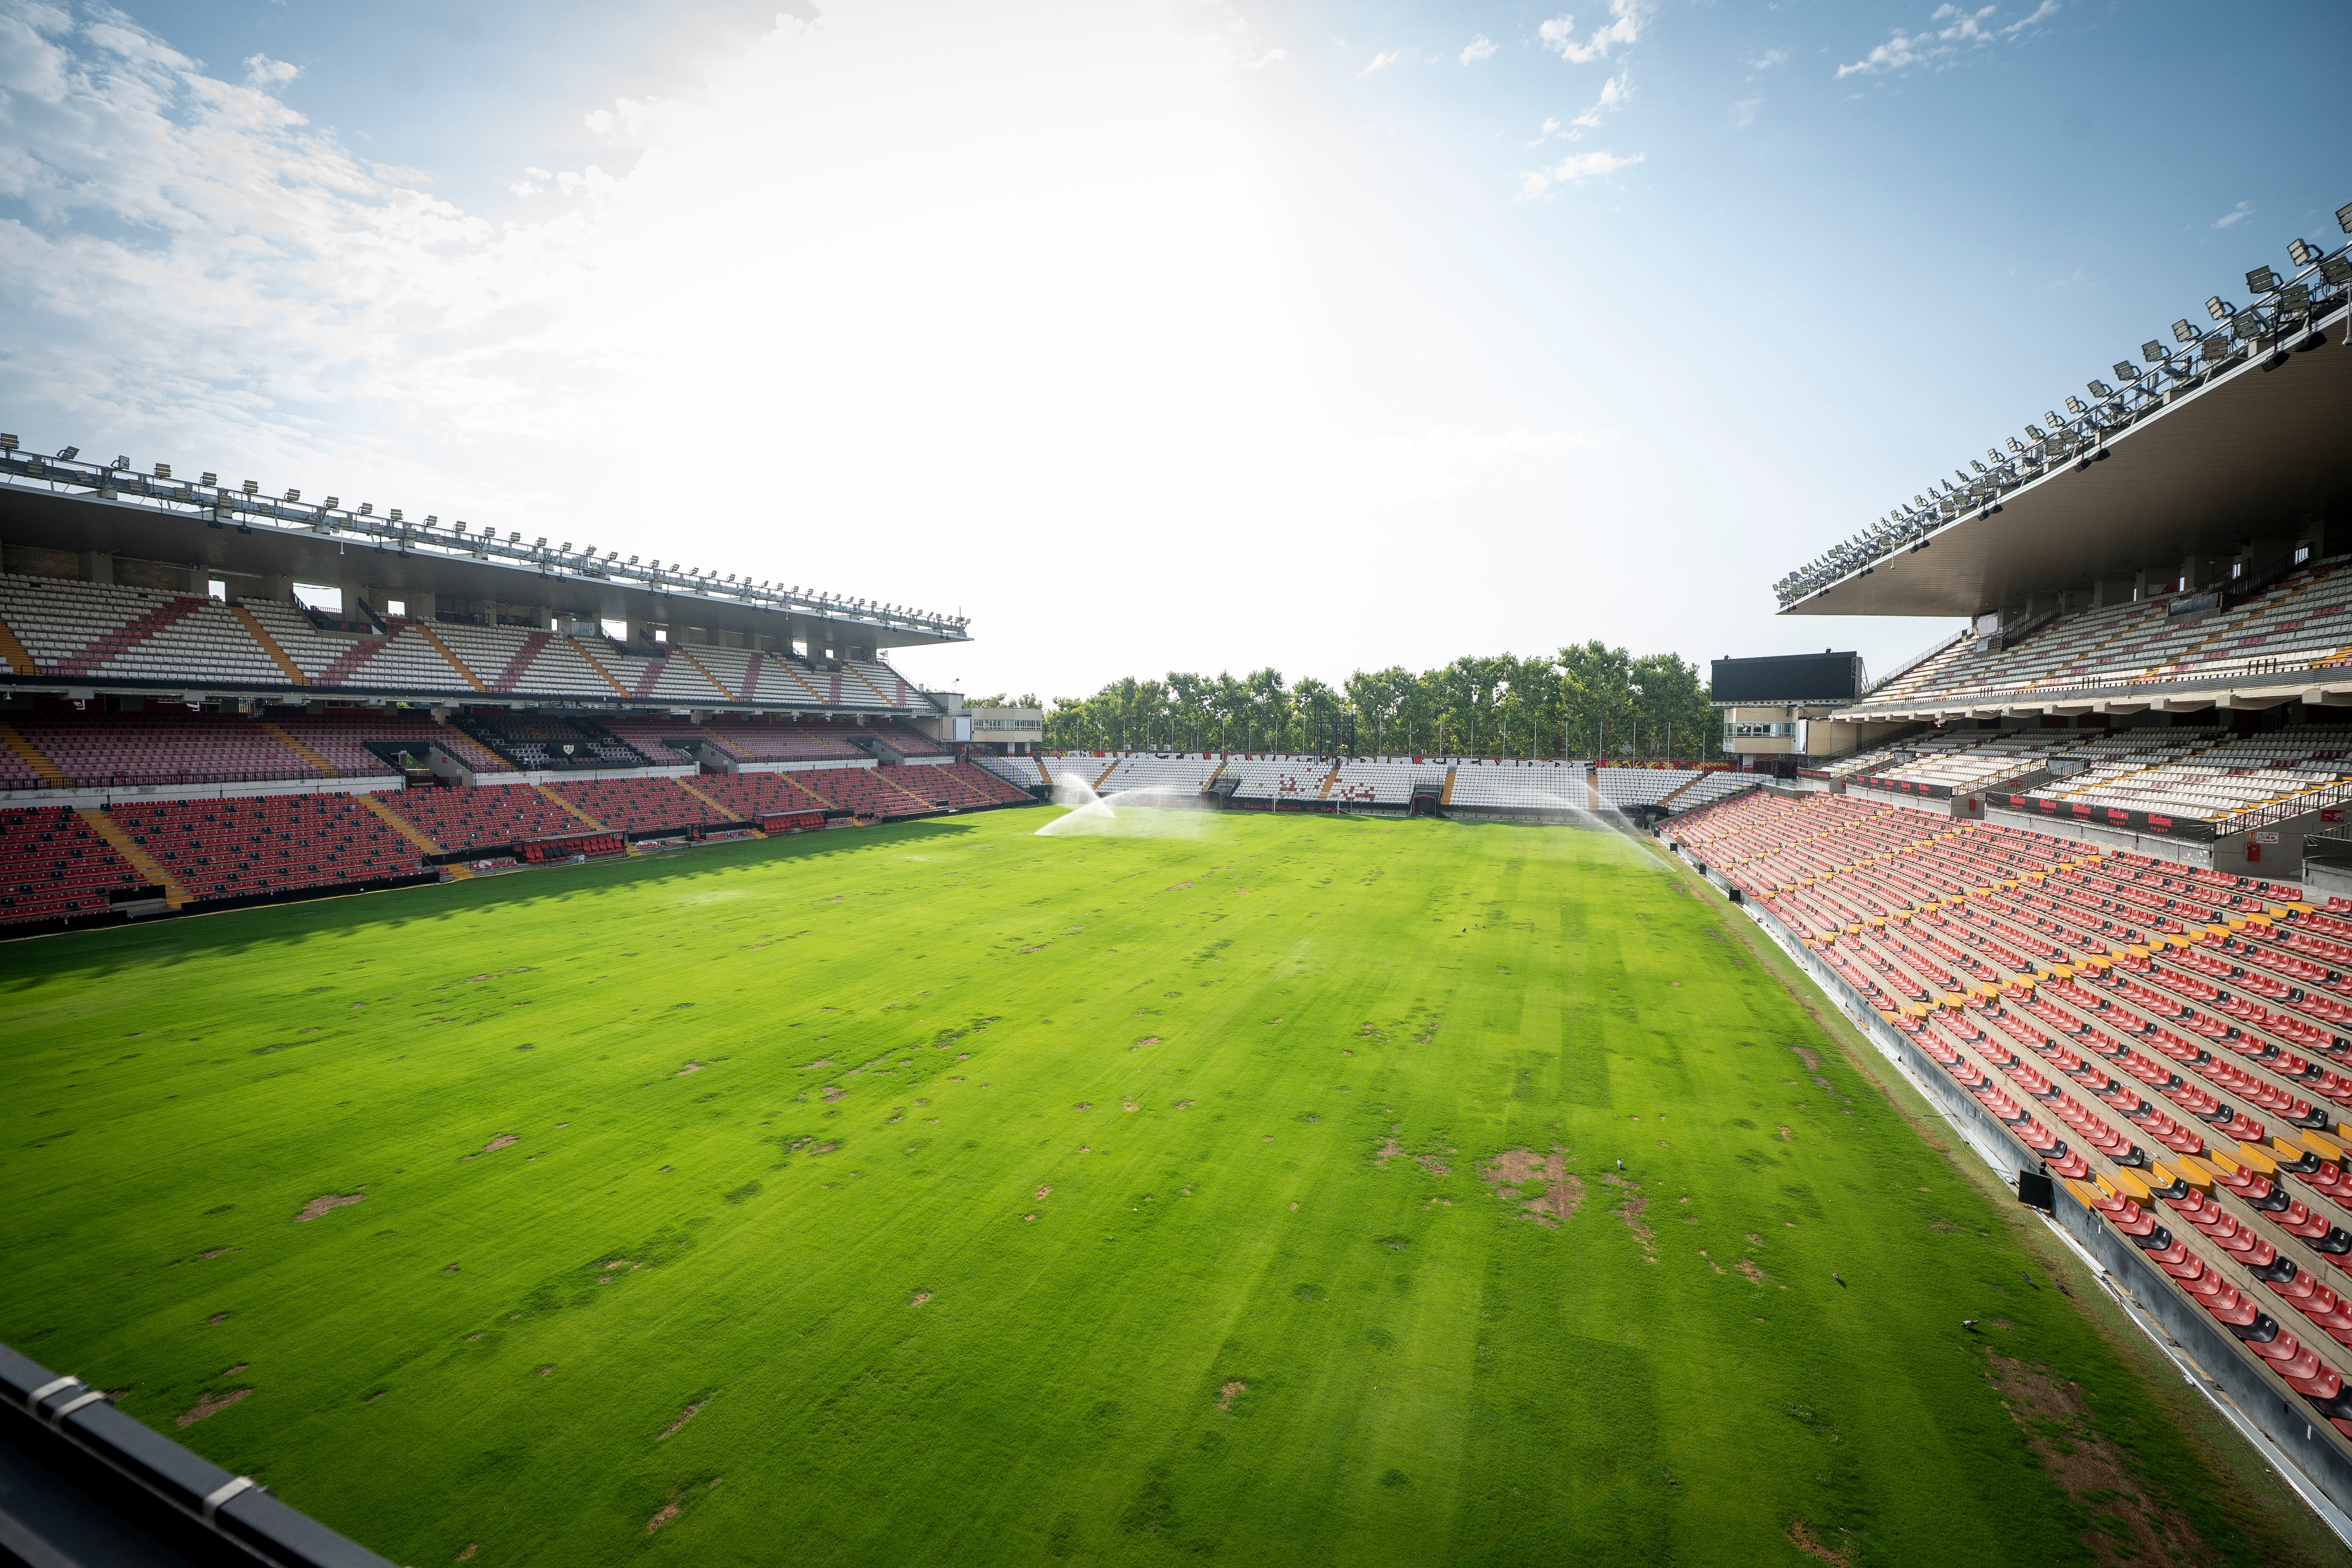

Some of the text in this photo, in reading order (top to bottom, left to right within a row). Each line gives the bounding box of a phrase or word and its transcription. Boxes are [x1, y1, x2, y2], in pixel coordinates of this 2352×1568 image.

[2039, 798, 2057, 809] Mahou
[2072, 803, 2091, 814] Mahou
[2107, 807, 2129, 820] Mahou
[2148, 813, 2172, 827] Mahou
